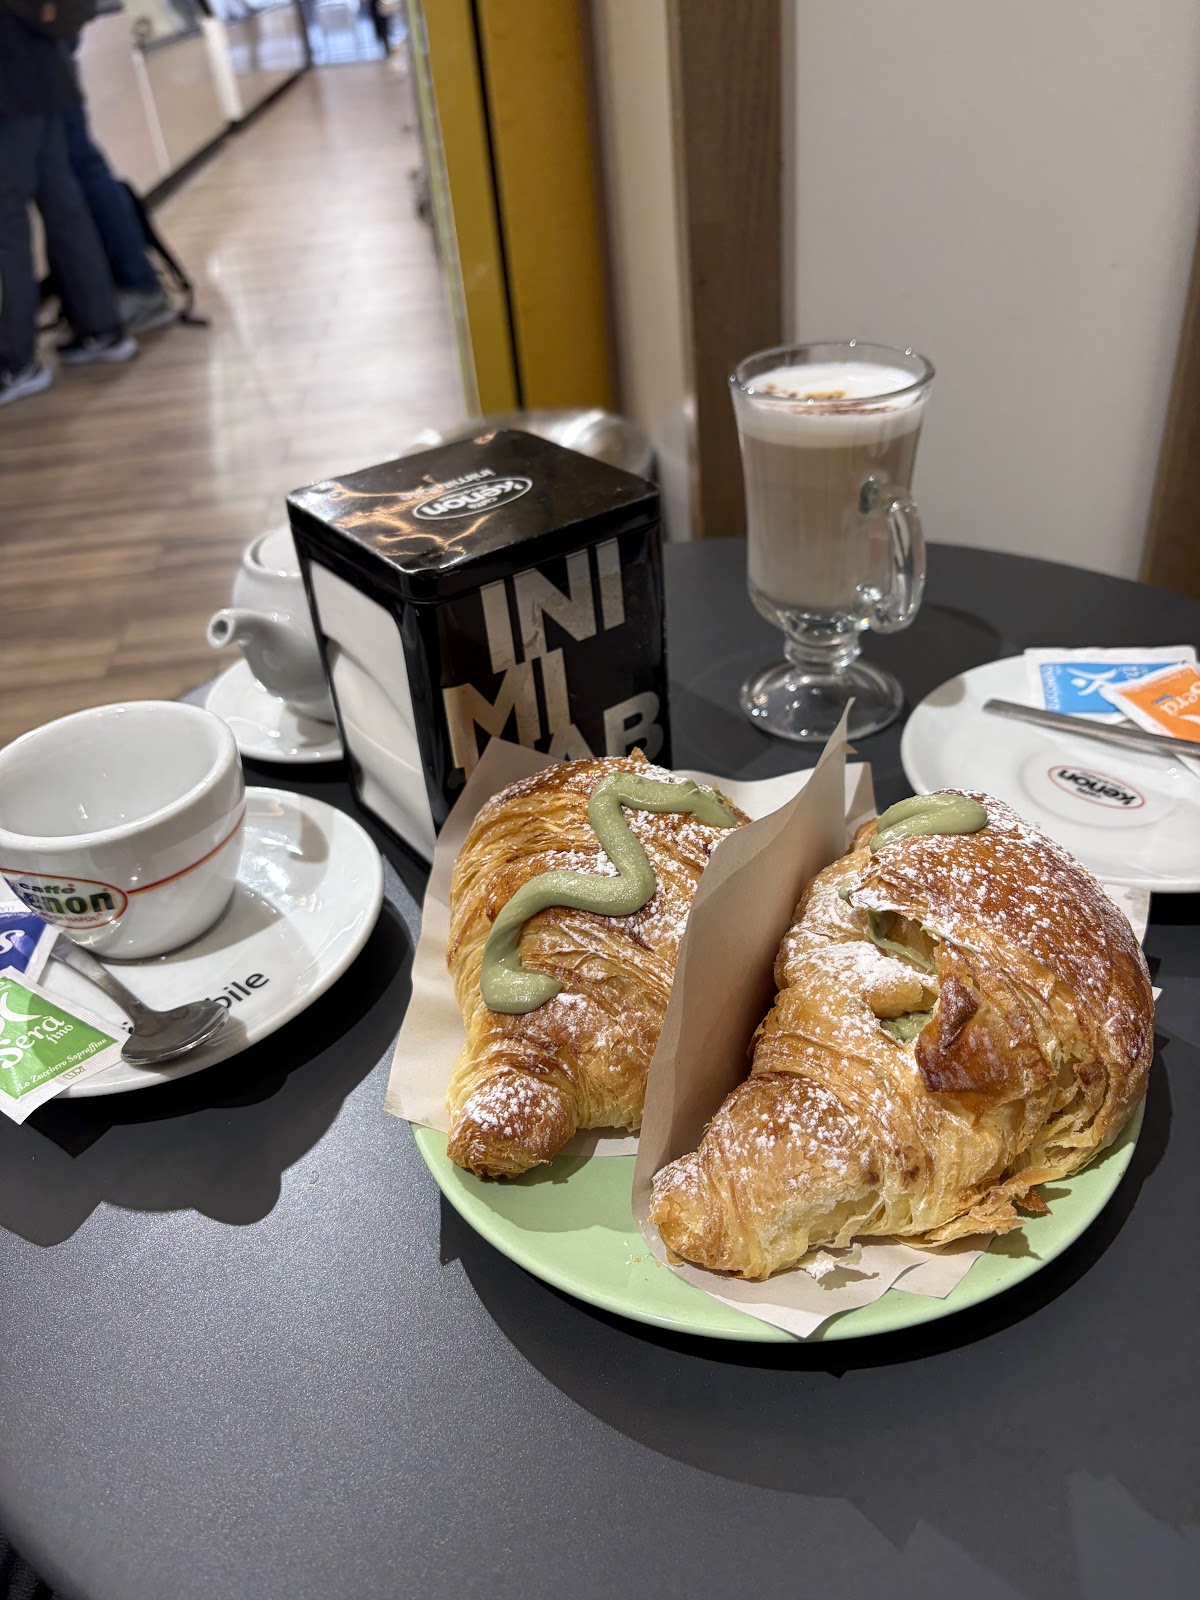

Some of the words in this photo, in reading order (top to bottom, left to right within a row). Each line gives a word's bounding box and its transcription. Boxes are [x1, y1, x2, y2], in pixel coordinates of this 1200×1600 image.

[420, 480, 525, 516] kenon
[480, 537, 626, 674] INI
[442, 648, 571, 770] MI
[1057, 769, 1136, 806] kenon
[22, 892, 115, 915] enon
[19, 1080, 31, 1091] Lo
[30, 1059, 68, 1084] Zucchero
[66, 1037, 108, 1064] Sopraffino
